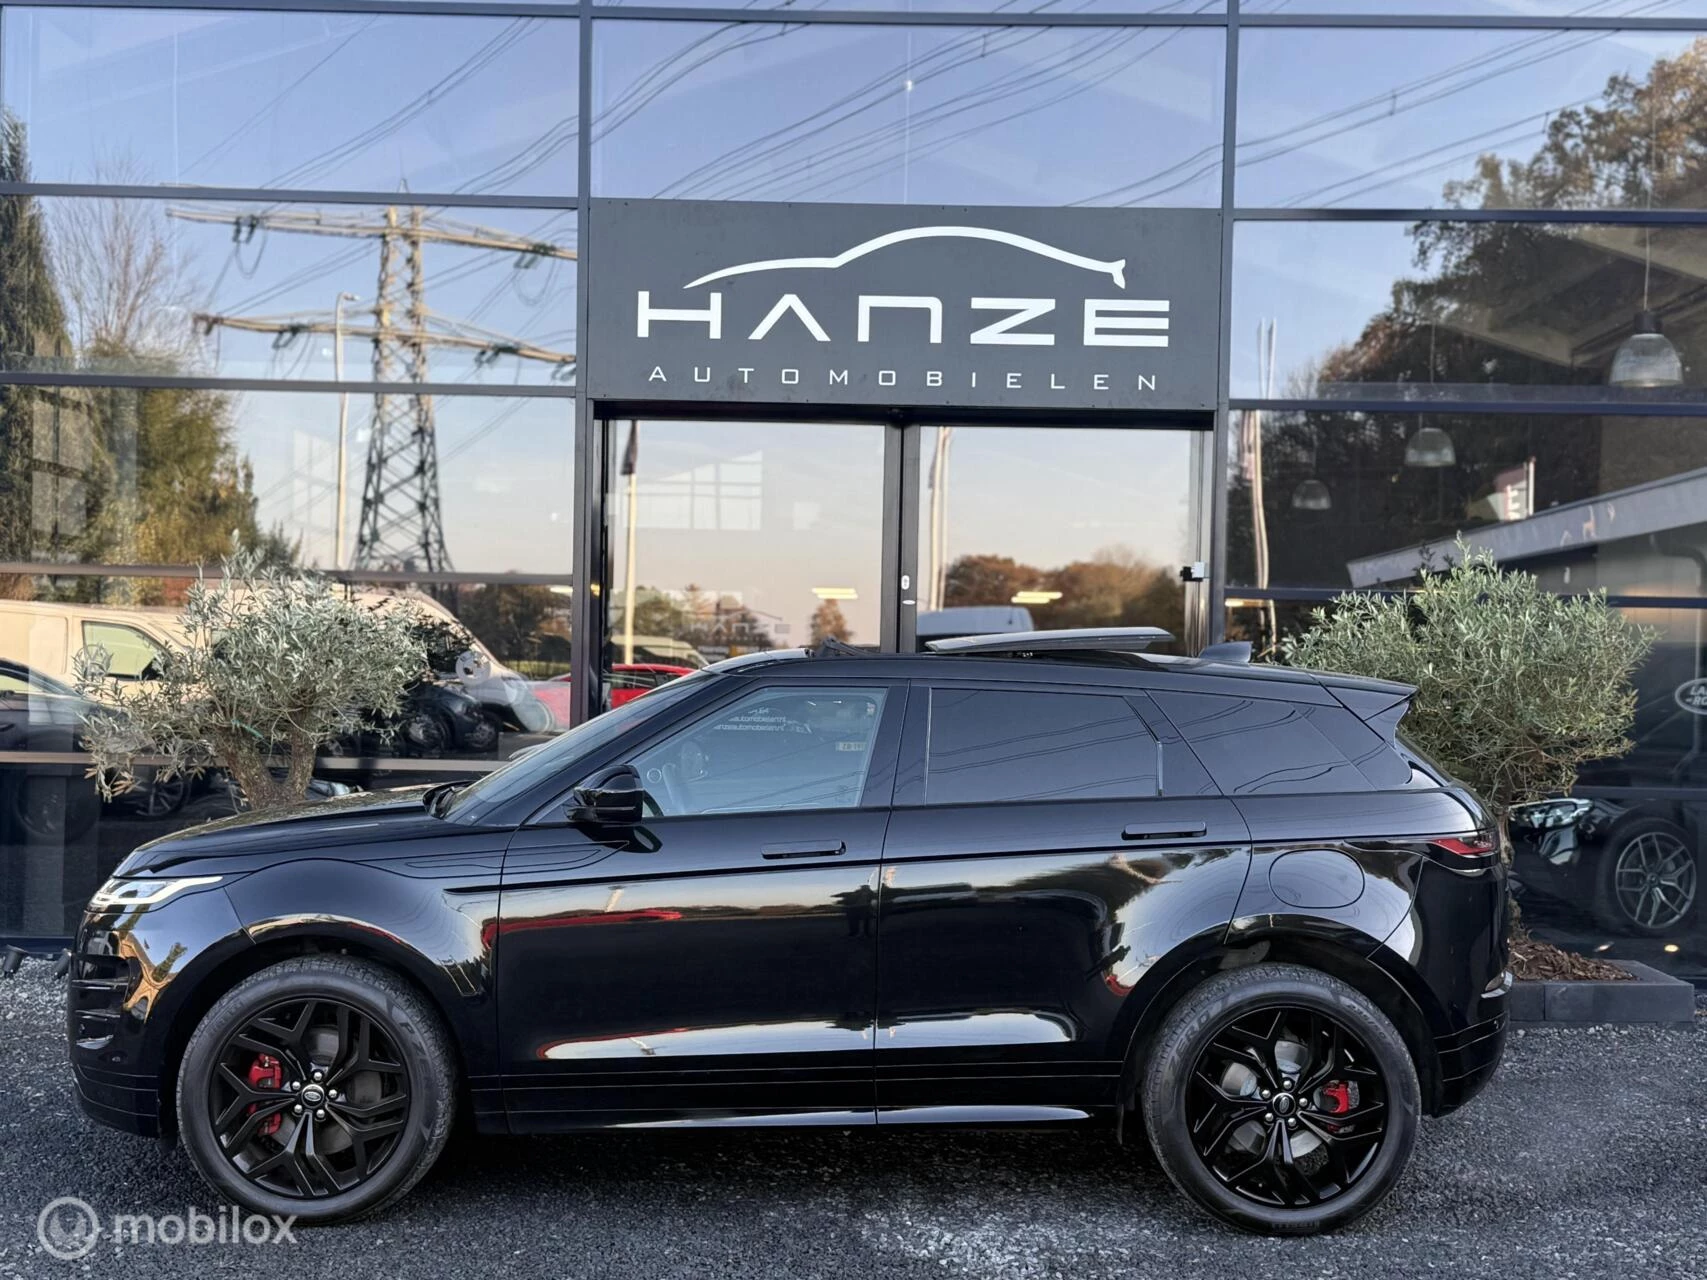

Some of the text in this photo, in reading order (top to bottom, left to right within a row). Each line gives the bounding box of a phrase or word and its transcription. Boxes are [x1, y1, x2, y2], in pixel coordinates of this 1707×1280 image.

[636, 290, 1170, 347] HANZE
[648, 365, 1156, 392] AUTOMOBIELEN
[1690, 685, 1707, 695] LA
[1168, 1010, 1211, 1076] ZERO
